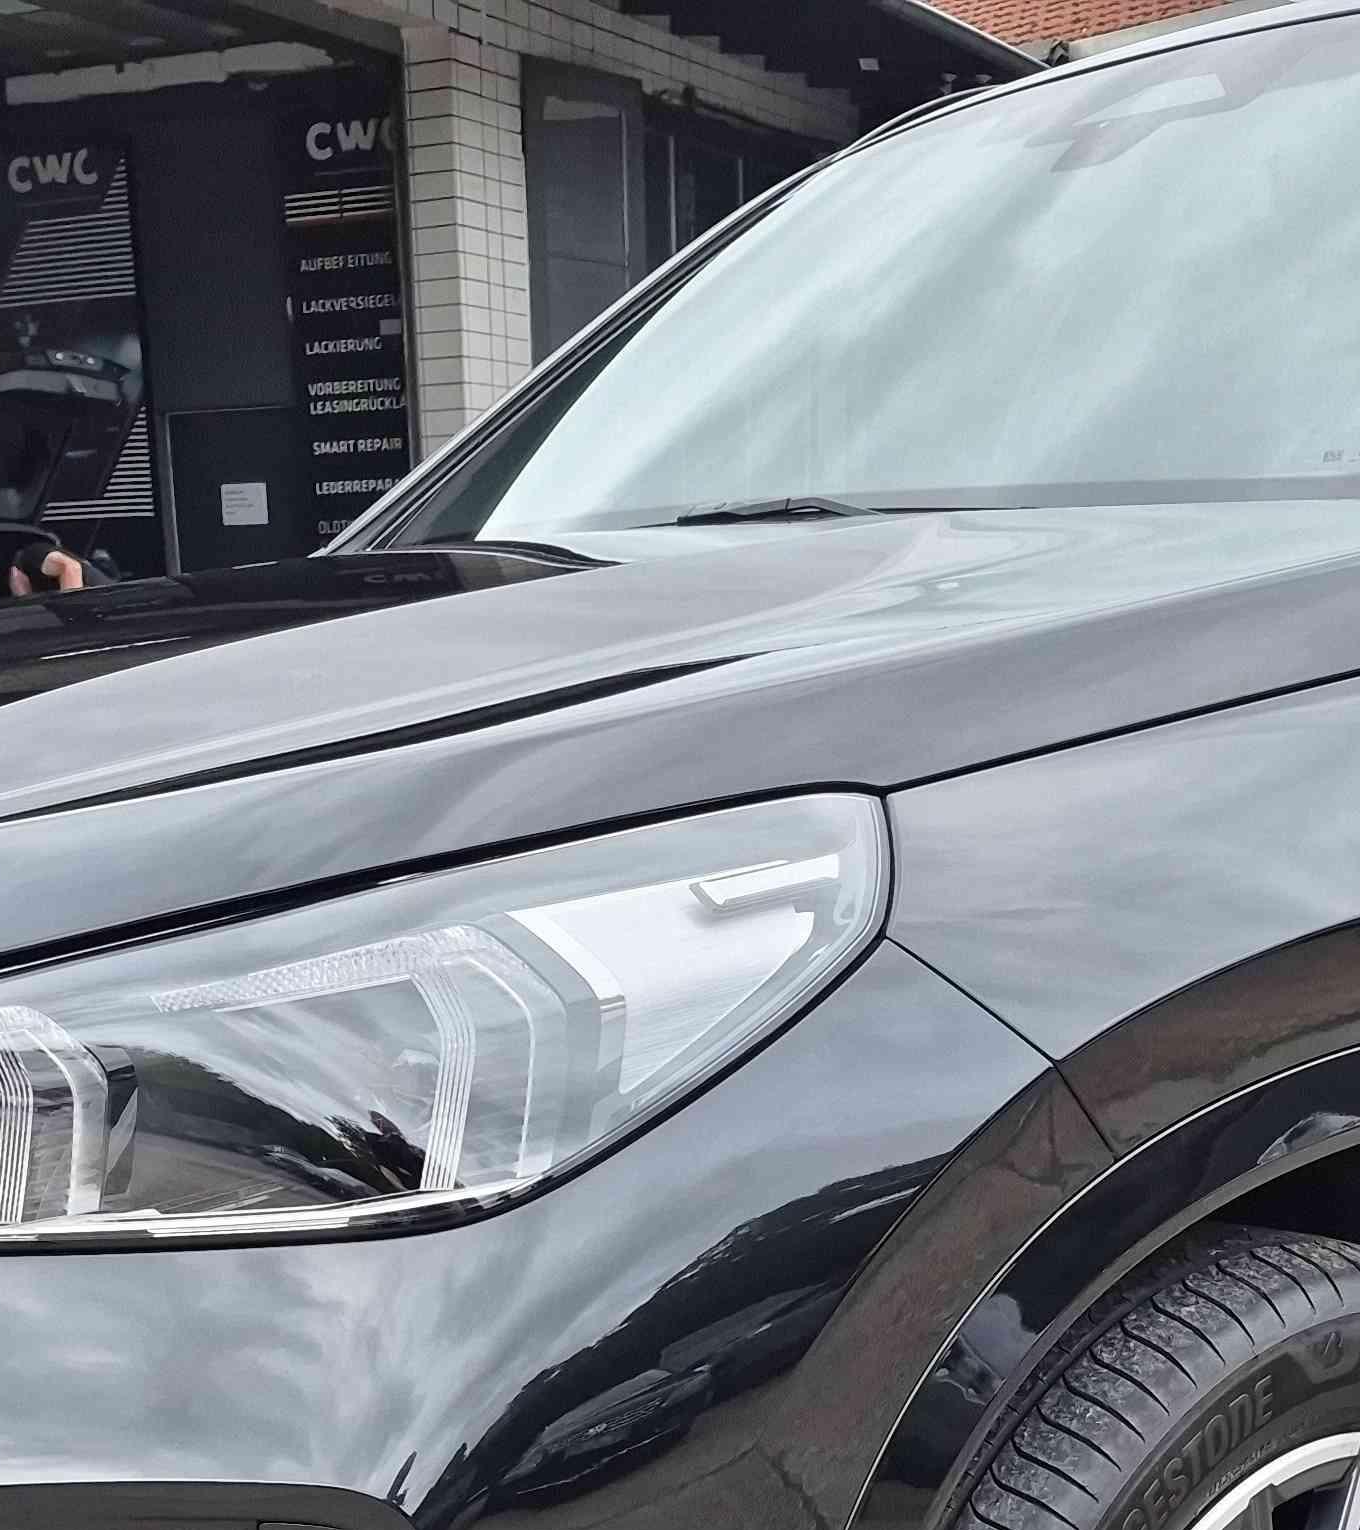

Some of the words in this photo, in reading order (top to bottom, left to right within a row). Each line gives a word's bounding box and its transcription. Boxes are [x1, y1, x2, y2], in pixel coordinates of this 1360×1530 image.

[6, 147, 98, 194] CWC
[305, 336, 382, 355] LACKIERUNG
[307, 377, 401, 396] VORBEREITUNG
[312, 439, 354, 456] SMART
[357, 437, 402, 452] REPAIR
[315, 478, 399, 496] LEDERREPAR
